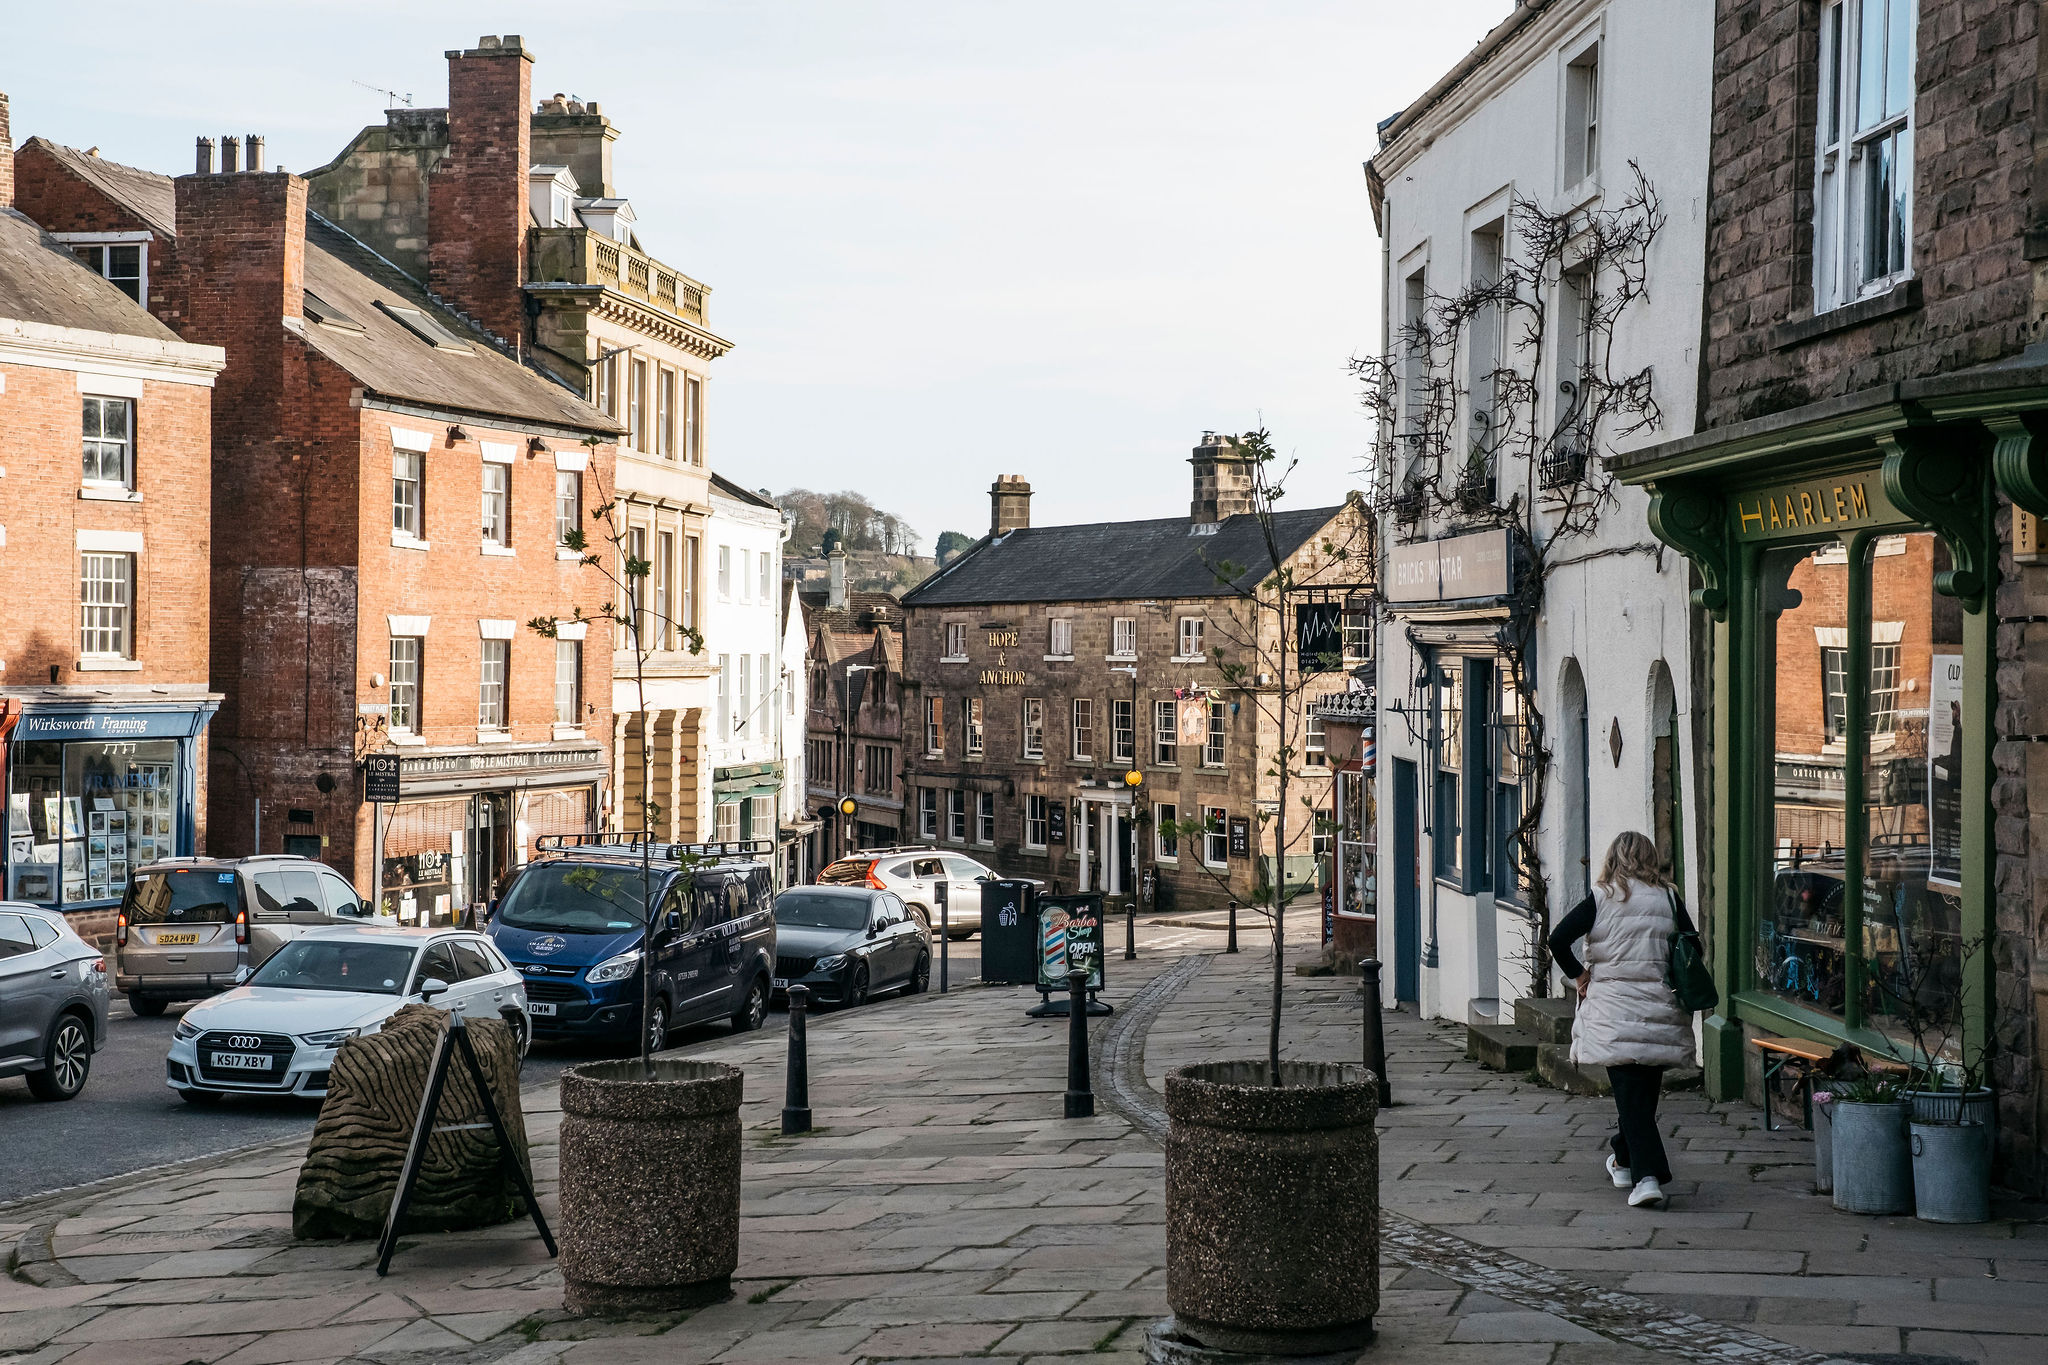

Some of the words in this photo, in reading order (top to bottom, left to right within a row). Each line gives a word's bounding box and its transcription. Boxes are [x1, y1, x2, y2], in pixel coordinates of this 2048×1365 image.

[1739, 483, 1869, 534] HAARLEM
[1398, 560, 1424, 586] BRICKS
[1428, 556, 1462, 583] MORTAR
[988, 632, 1018, 647] HOPE
[998, 651, 1006, 667] &
[979, 670, 1026, 685] ANCHOR
[29, 717, 95, 731] Wirksworth
[101, 716, 148, 733] Framing
[403, 762, 418, 771] BAR
[427, 761, 456, 771] BISTRO
[486, 757, 495, 768] LE
[496, 754, 528, 767] MISTRAL
[1051, 912, 1098, 928] Barber
[159, 935, 178, 943] SD24
[180, 935, 196, 943] HVB
[1067, 926, 1092, 939] Shop
[217, 1055, 241, 1067] KS17
[244, 1056, 266, 1068] XBY
